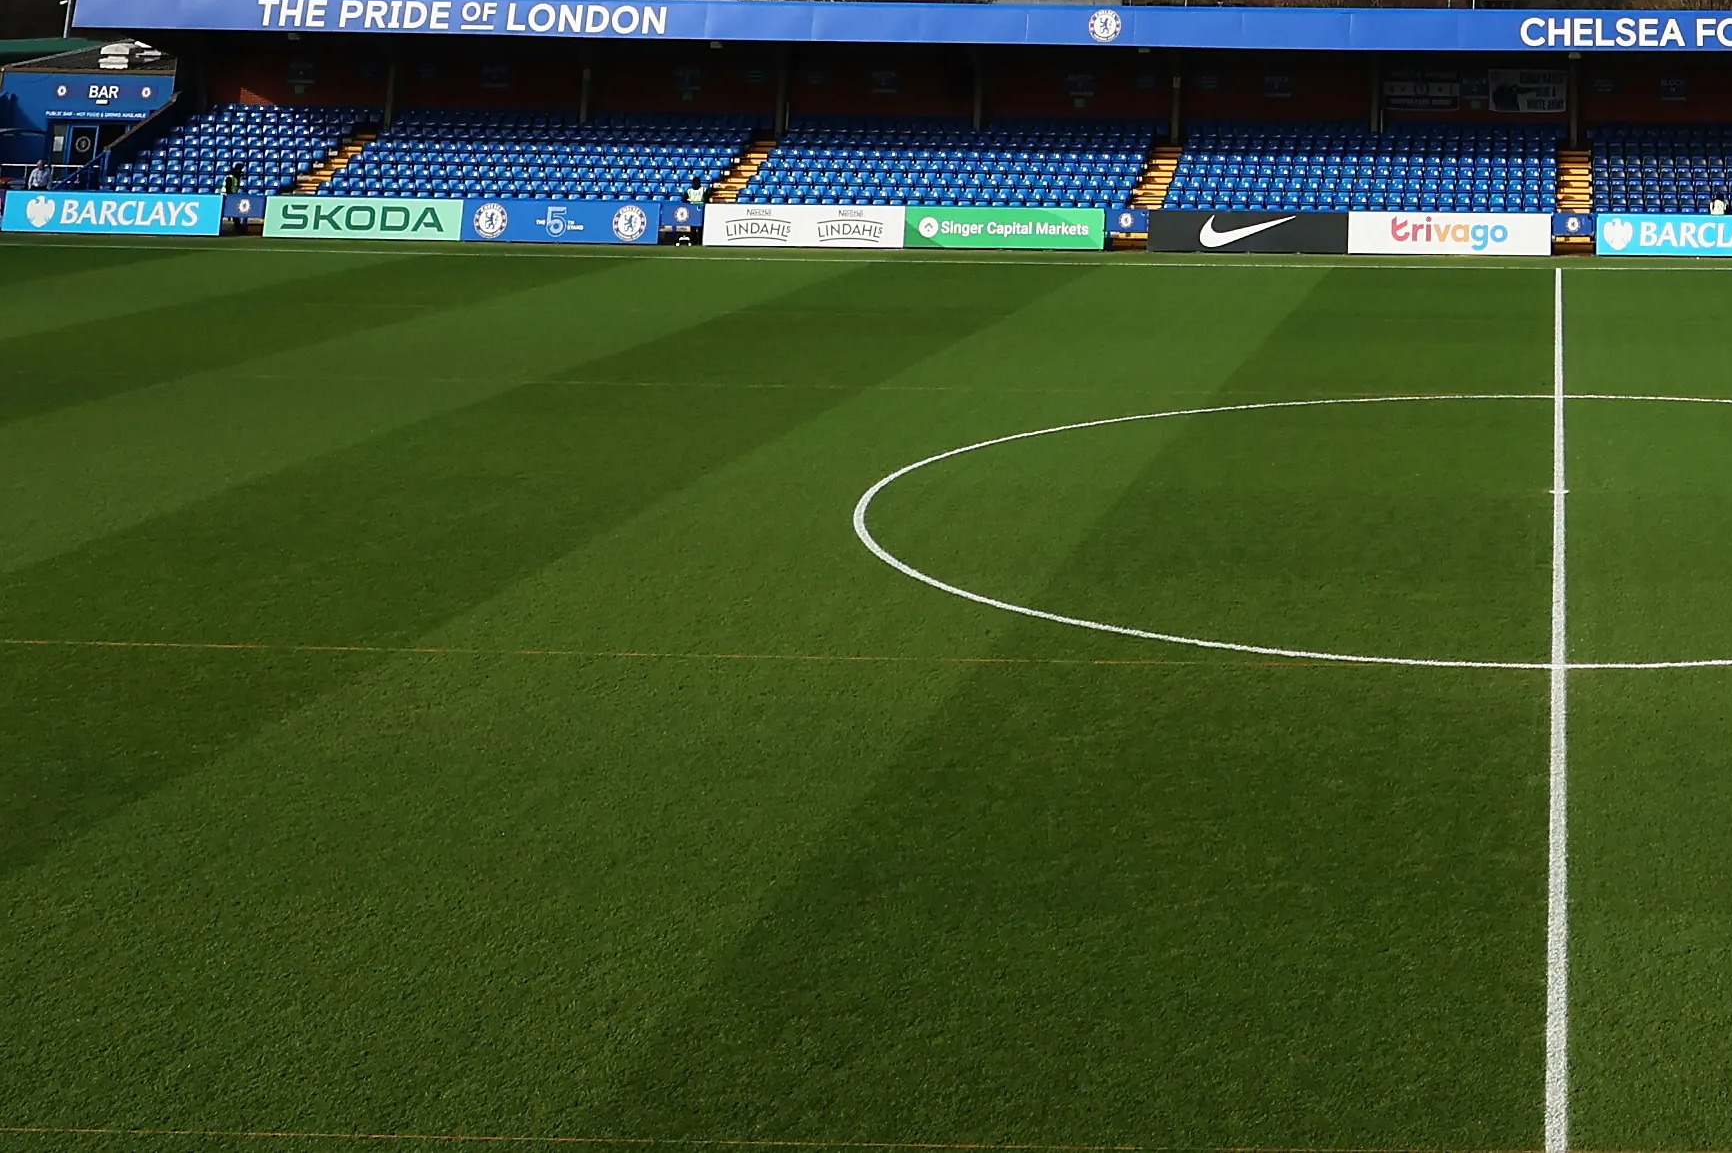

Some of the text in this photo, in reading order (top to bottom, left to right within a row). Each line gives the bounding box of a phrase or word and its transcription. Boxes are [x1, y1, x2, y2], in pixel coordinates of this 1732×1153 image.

[258, 0, 668, 34] THE PRIDE OF LONDON
[1520, 18, 1686, 47] CHELSEA
[89, 86, 119, 99] BAR
[60, 199, 200, 227] BARCLAYS
[546, 206, 567, 237] 5
[941, 221, 1089, 237] Singer Capital Markets
[1391, 216, 1508, 251] trivago
